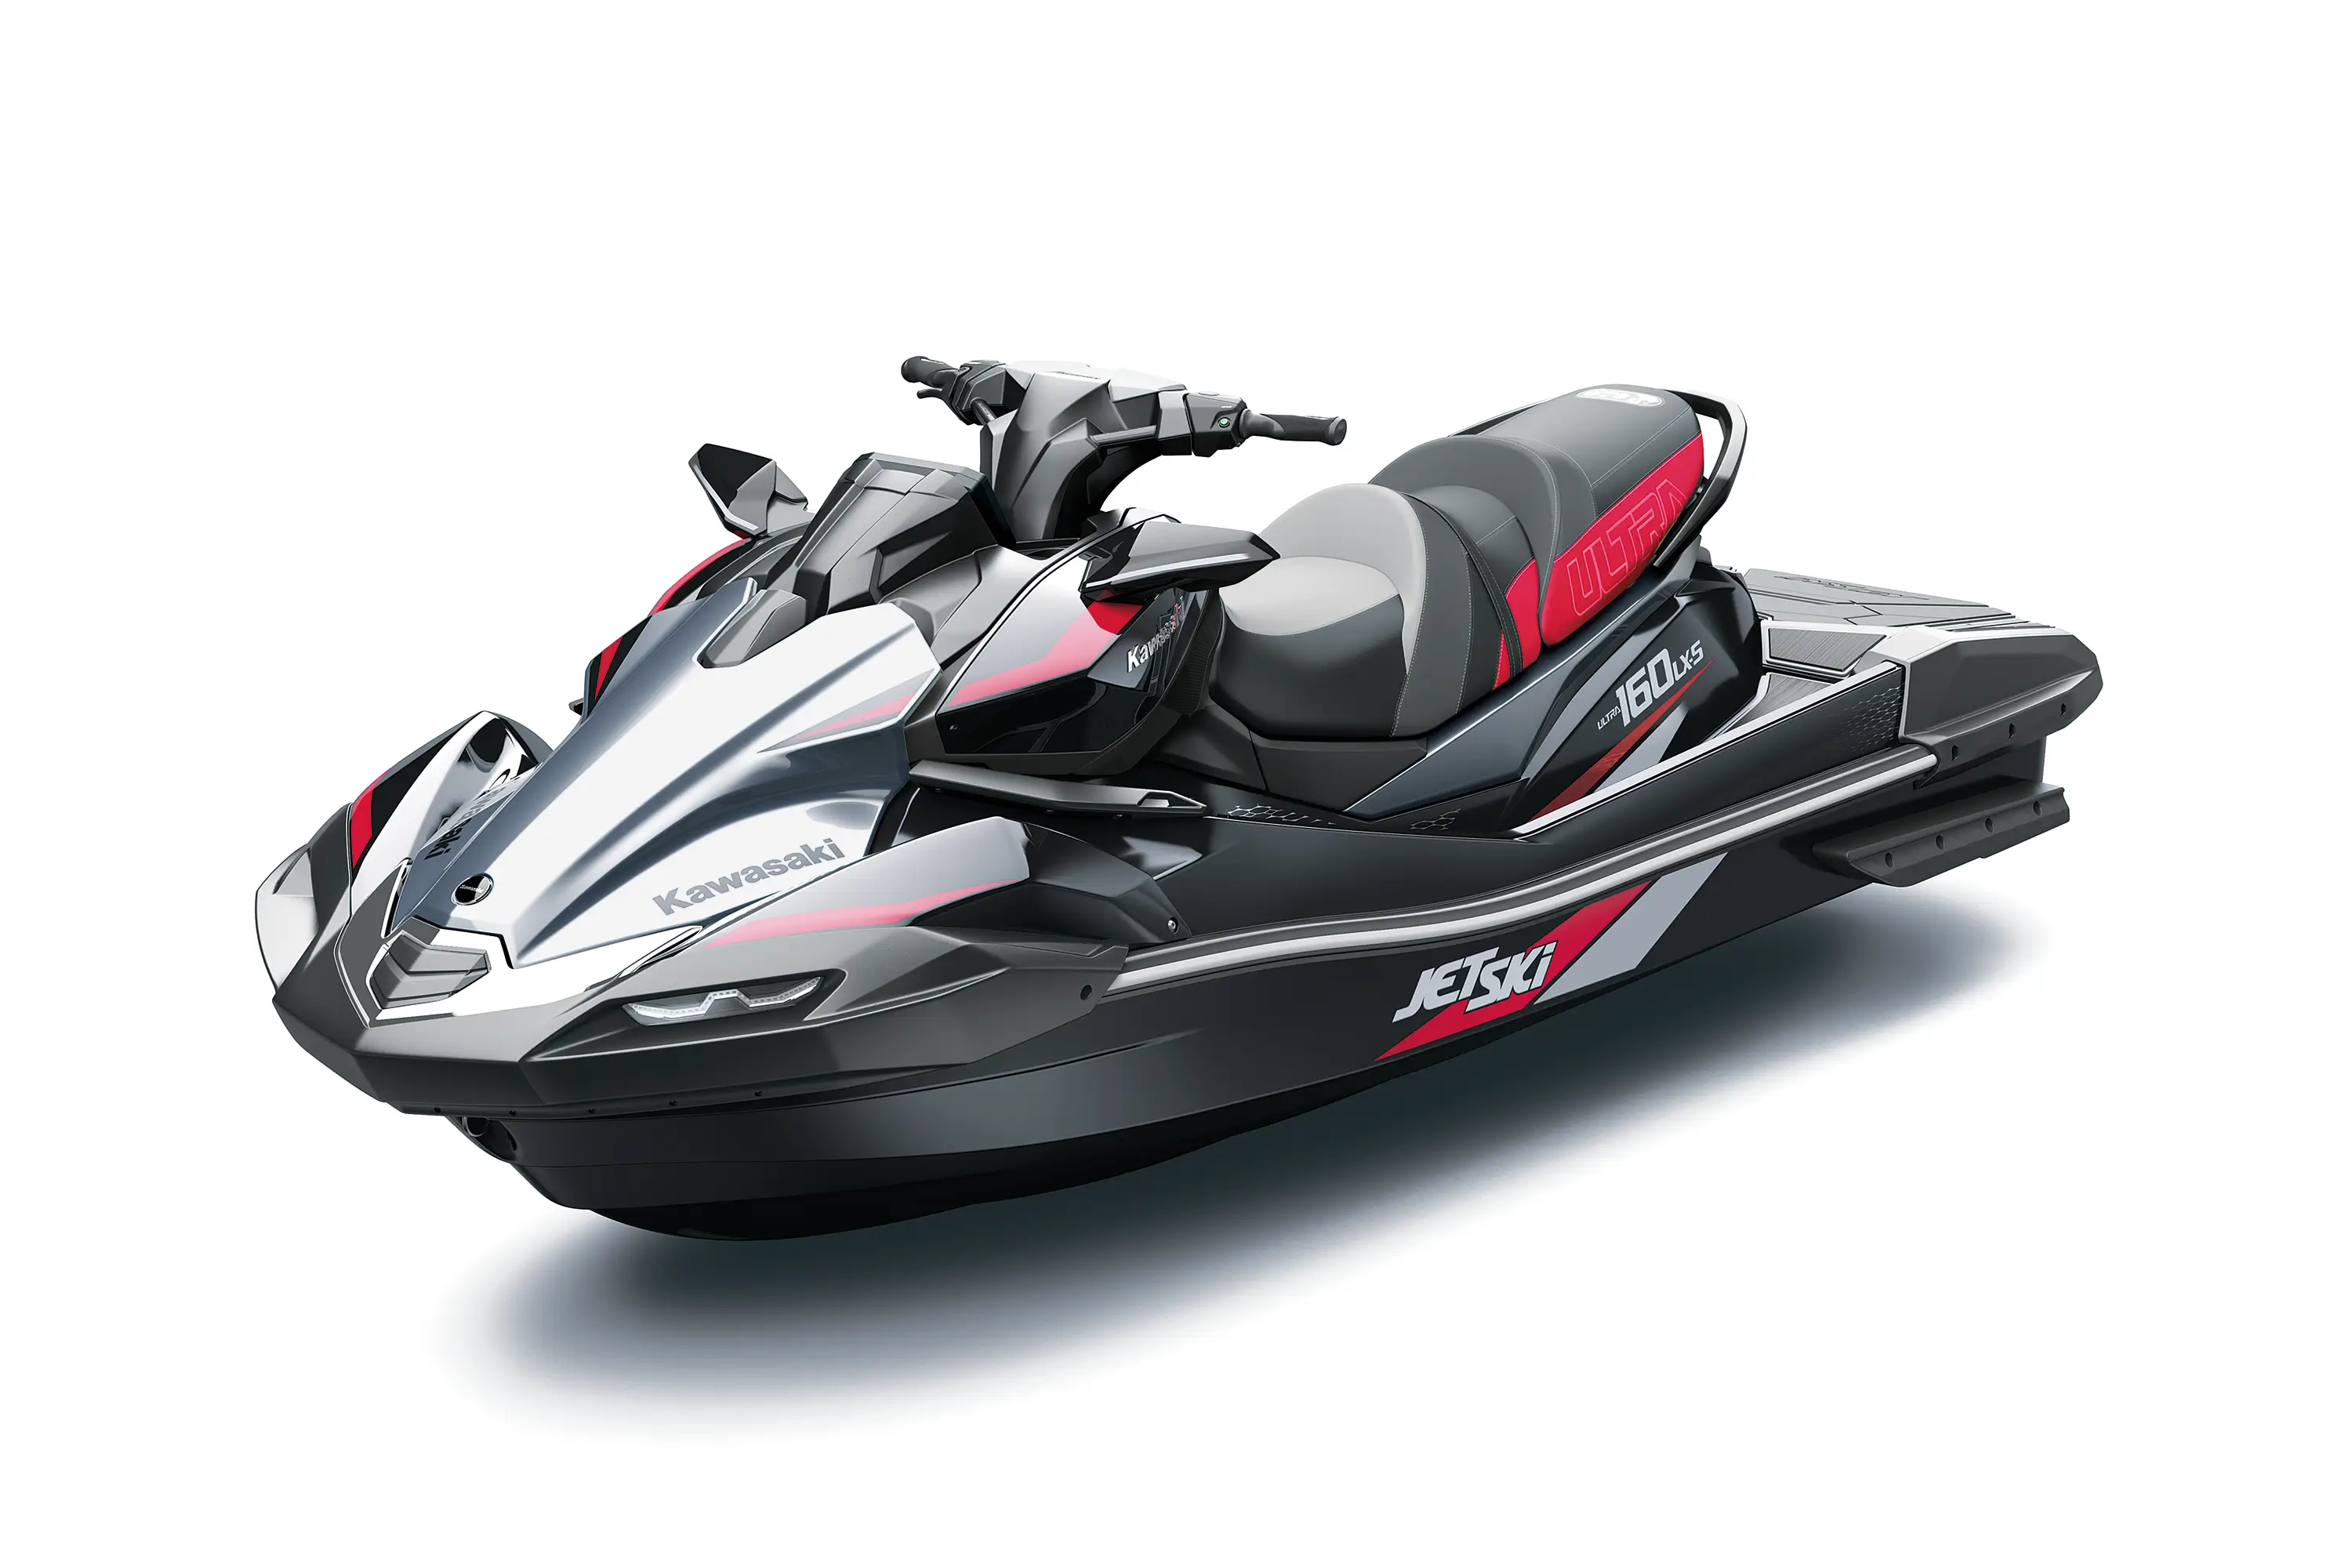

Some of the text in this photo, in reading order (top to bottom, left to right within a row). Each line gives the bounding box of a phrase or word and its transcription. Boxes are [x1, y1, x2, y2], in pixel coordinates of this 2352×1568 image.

[1597, 640, 1704, 730] ULTRA 160 LX-S
[652, 838, 845, 915] Kawasaki
